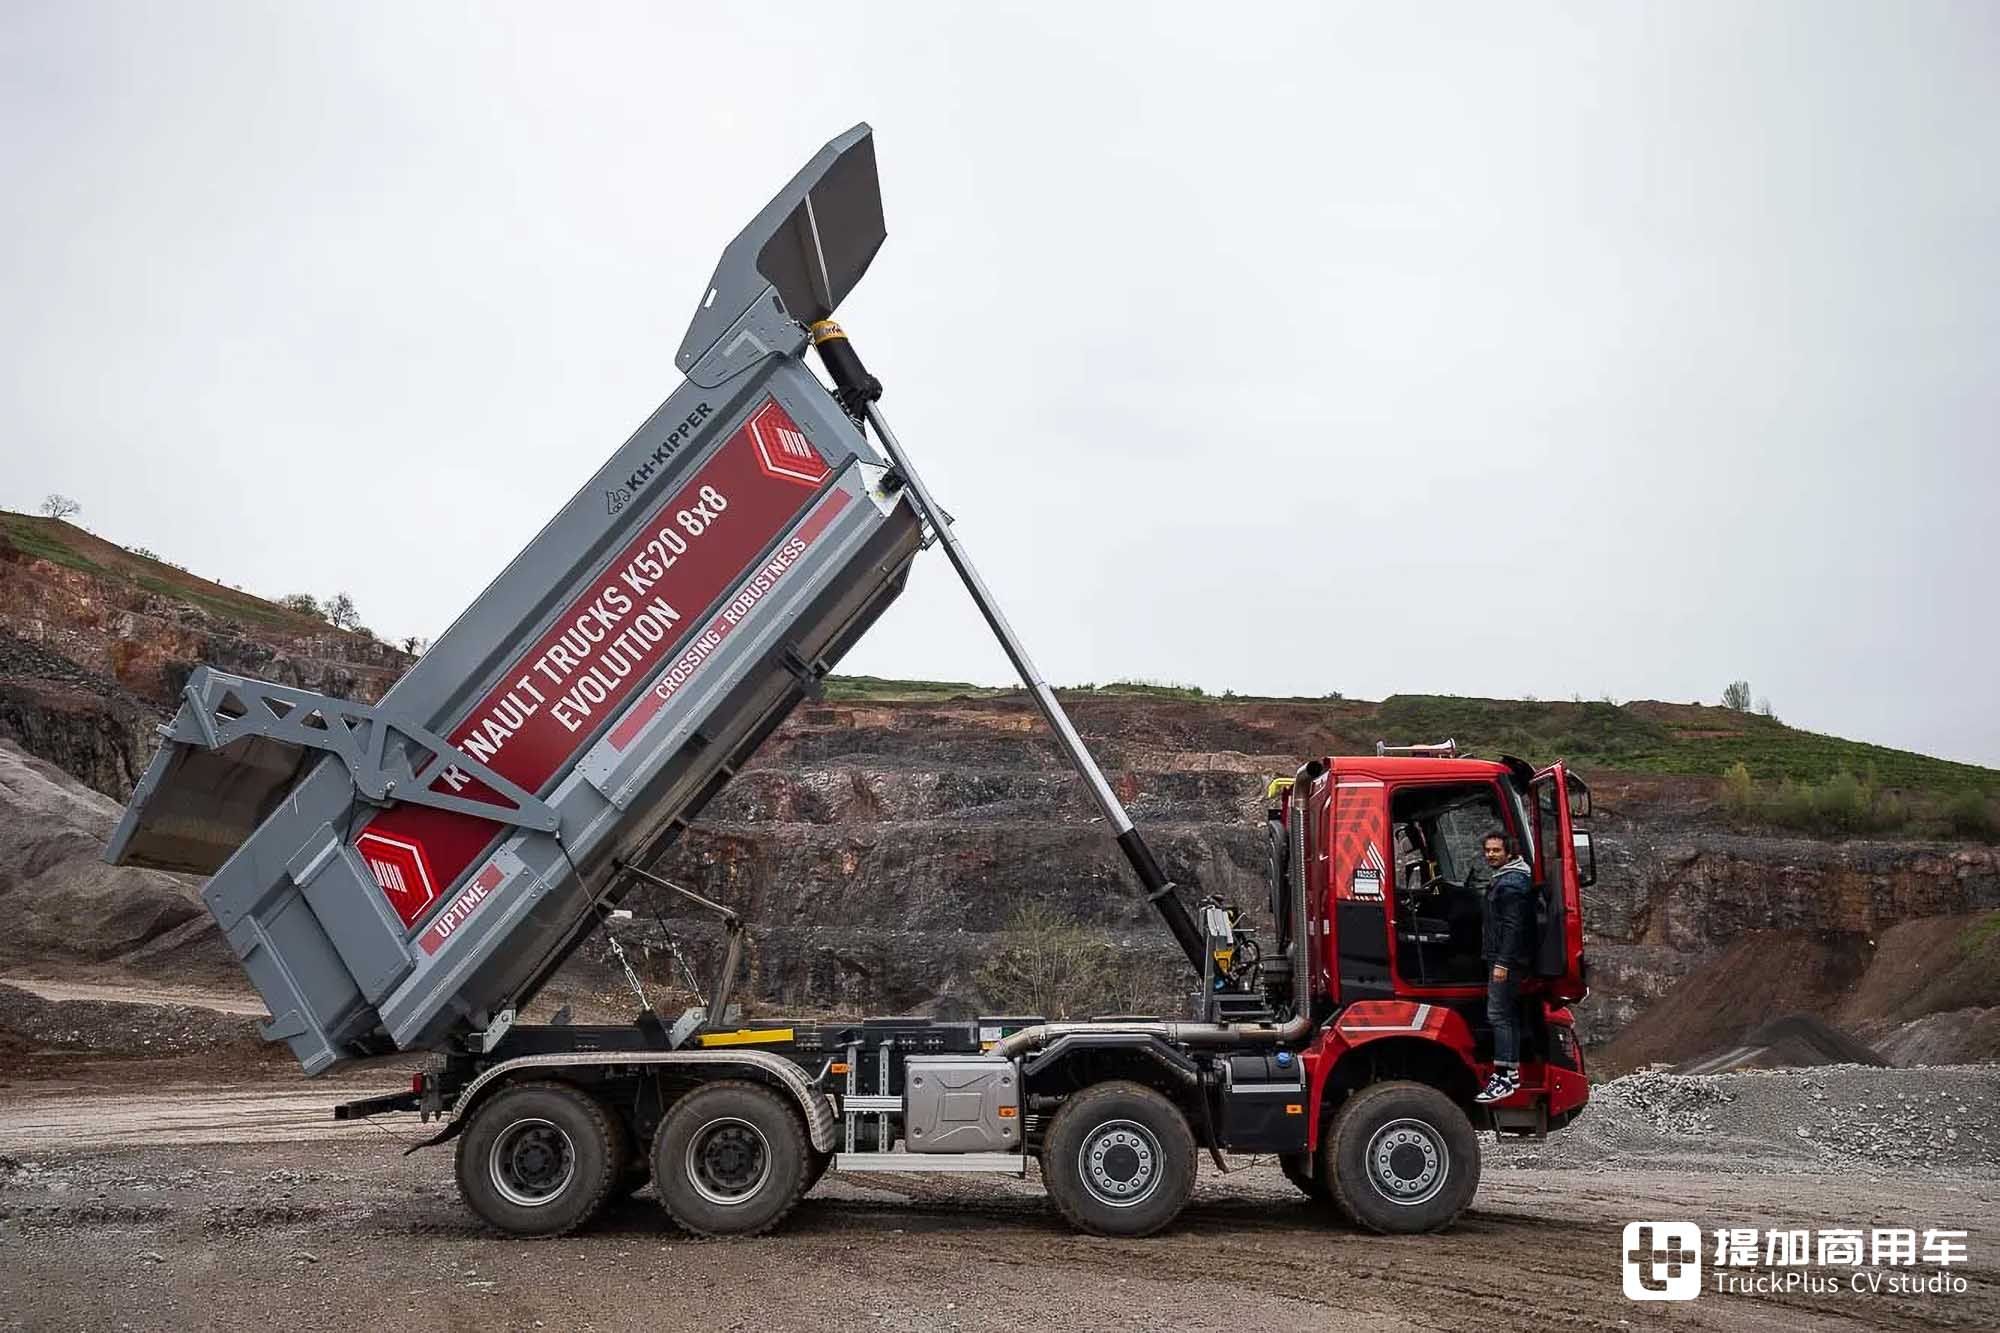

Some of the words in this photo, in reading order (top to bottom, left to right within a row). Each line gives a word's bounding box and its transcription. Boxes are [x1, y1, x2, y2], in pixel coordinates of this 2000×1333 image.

[625, 402, 713, 492] KH-KIPPER
[441, 675, 546, 792] RNAULT
[533, 586, 633, 685] TRUCKS
[620, 527, 688, 596] K520
[676, 485, 728, 536] 8x8
[550, 596, 681, 733] EVOLUTION
[655, 629, 721, 700] CROSSING
[722, 537, 806, 625] ROBUSTNESS
[434, 881, 488, 938] UPTIME
